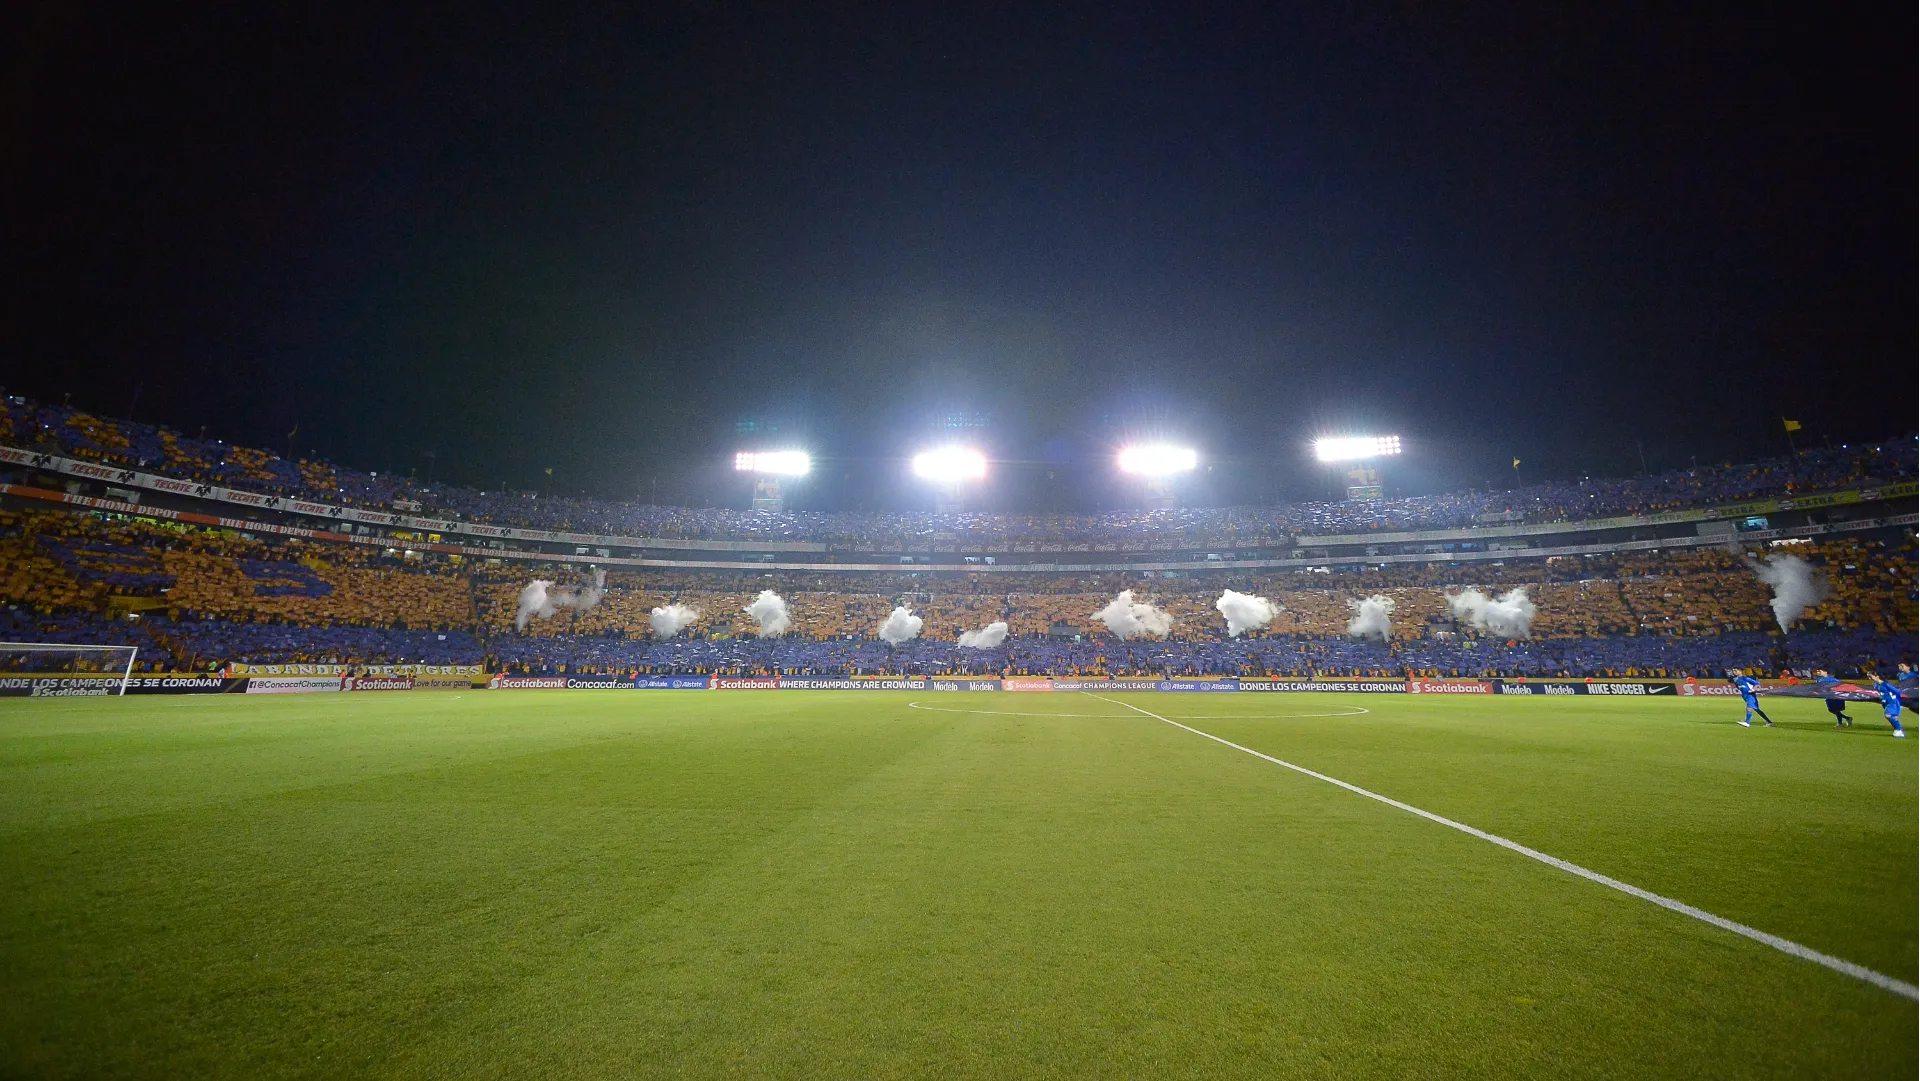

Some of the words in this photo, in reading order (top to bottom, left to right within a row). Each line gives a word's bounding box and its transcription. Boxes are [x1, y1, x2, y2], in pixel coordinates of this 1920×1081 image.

[71, 462, 117, 479] TECATE
[152, 479, 195, 494] TECATE
[227, 491, 262, 505] TECATE
[63, 493, 93, 507] THE
[95, 499, 135, 513] HOME
[137, 505, 180, 519] DEPOT
[295, 502, 328, 515] TECATE
[356, 511, 388, 524] TECATE
[218, 517, 242, 529] THE
[244, 521, 278, 533] HOME
[279, 526, 314, 538] DEPOT
[414, 519, 444, 530] TECATE
[1843, 520, 1870, 530] TECATE
[470, 526, 499, 536] TECATE
[519, 530, 545, 540] TECATE
[349, 534, 369, 545] THE
[372, 537, 401, 548] HOME
[401, 541, 434, 550] DEPOT
[265, 664, 343, 675] BANDA
[400, 664, 480, 675] TIGRES
[31, 678, 60, 690] LOS
[60, 678, 141, 689] CAMPEONES
[143, 678, 160, 687] SE
[162, 678, 222, 688] CORONAN
[257, 680, 340, 689] @ConcacafChampions
[355, 678, 412, 691] Scotiabank
[413, 678, 429, 688] Love
[430, 679, 440, 687] for
[453, 680, 472, 689] game
[502, 679, 564, 688] Scotiabank
[567, 679, 635, 689] Concacaf.com
[681, 680, 702, 688] Allstate
[720, 680, 776, 689] Scotiabank
[779, 680, 809, 689] WHERE
[811, 680, 861, 689] CHAMPIONS
[862, 681, 880, 689] ARE
[881, 681, 925, 689] CROWNED
[933, 682, 958, 692] Modelo
[969, 682, 994, 692] Modelo
[1171, 682, 1195, 690] Allstate
[1239, 682, 1271, 691] DONDE
[1271, 682, 1290, 691] LOS
[1291, 682, 1346, 691] CAMPEONES
[1347, 683, 1359, 691] SE
[1360, 683, 1406, 692] CORONAN
[1424, 683, 1486, 693] Scotiabank
[1587, 683, 1611, 695] NIKE
[1611, 684, 1646, 695] SOCCER
[41, 687, 109, 697] Scotiabank
[1501, 684, 1532, 695] Modelo
[1544, 684, 1575, 695] Modelo
